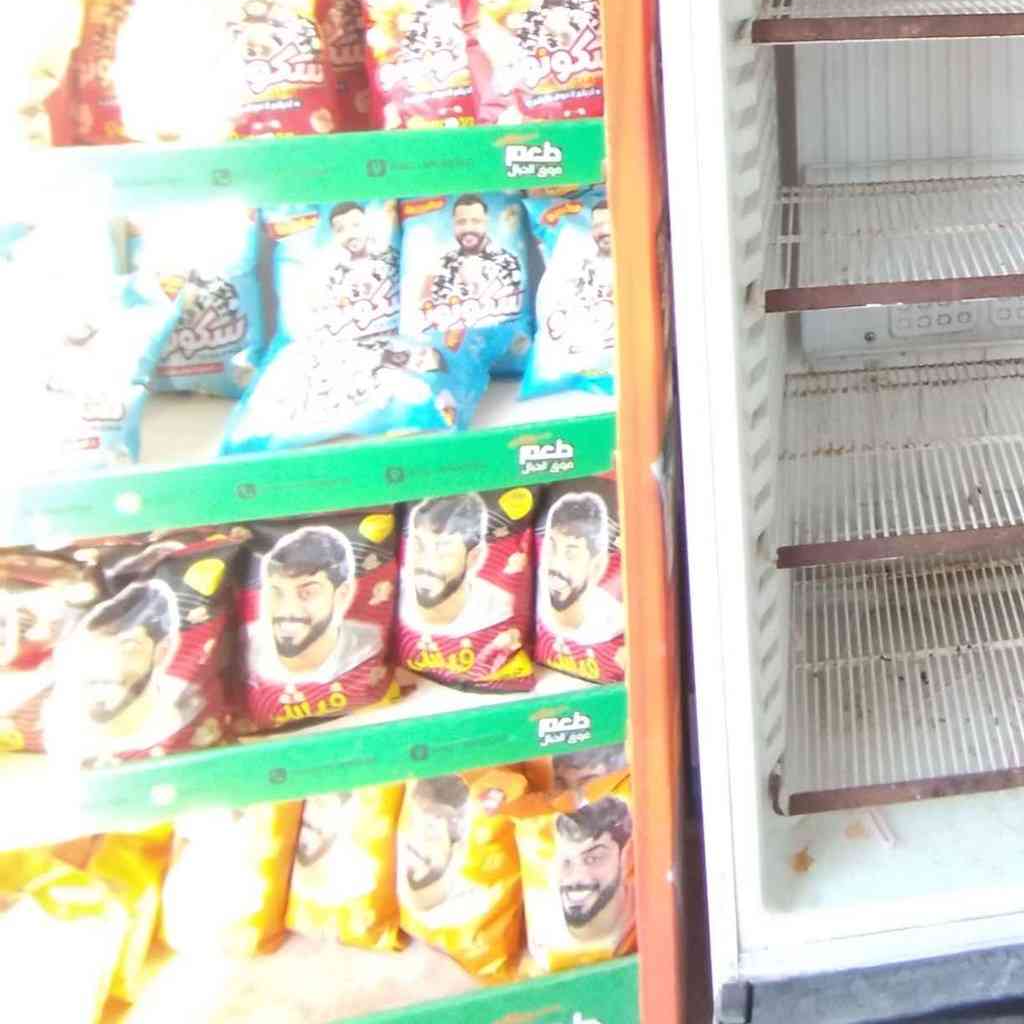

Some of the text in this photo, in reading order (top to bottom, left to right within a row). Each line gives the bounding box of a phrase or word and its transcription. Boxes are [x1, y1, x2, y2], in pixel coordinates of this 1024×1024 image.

[505, 141, 562, 165] طعم
[518, 438, 574, 464] طعم
[538, 711, 591, 737] طعم
